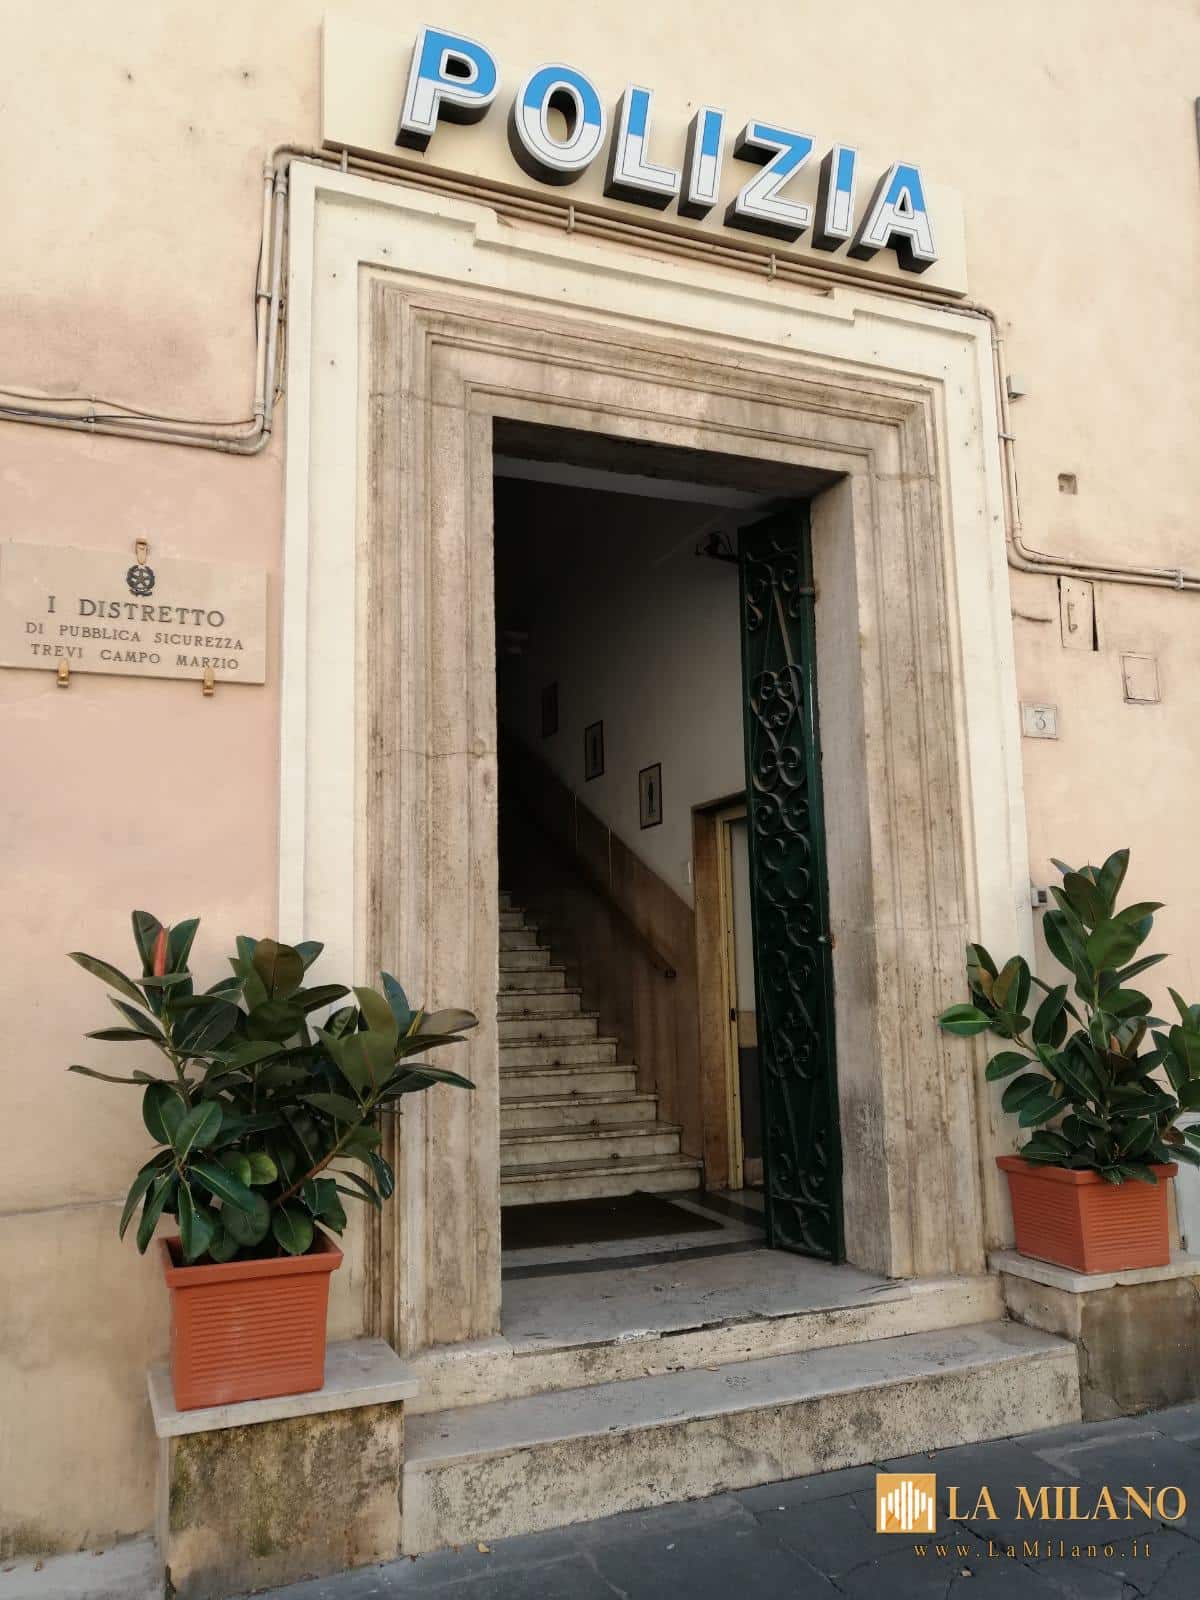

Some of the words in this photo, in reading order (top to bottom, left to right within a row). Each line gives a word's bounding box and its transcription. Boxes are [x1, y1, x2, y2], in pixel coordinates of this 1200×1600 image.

[396, 24, 939, 274] POLIZIA
[48, 595, 56, 613] I
[79, 599, 225, 628] DISTRETTO
[26, 622, 44, 634] DI
[59, 624, 141, 642] PUBBLICA
[154, 633, 244, 650] SICUREZZA
[31, 643, 83, 658] TREVI
[100, 649, 161, 664] CAMPO
[176, 655, 239, 670] MARZIO
[1034, 710, 1047, 730] 3
